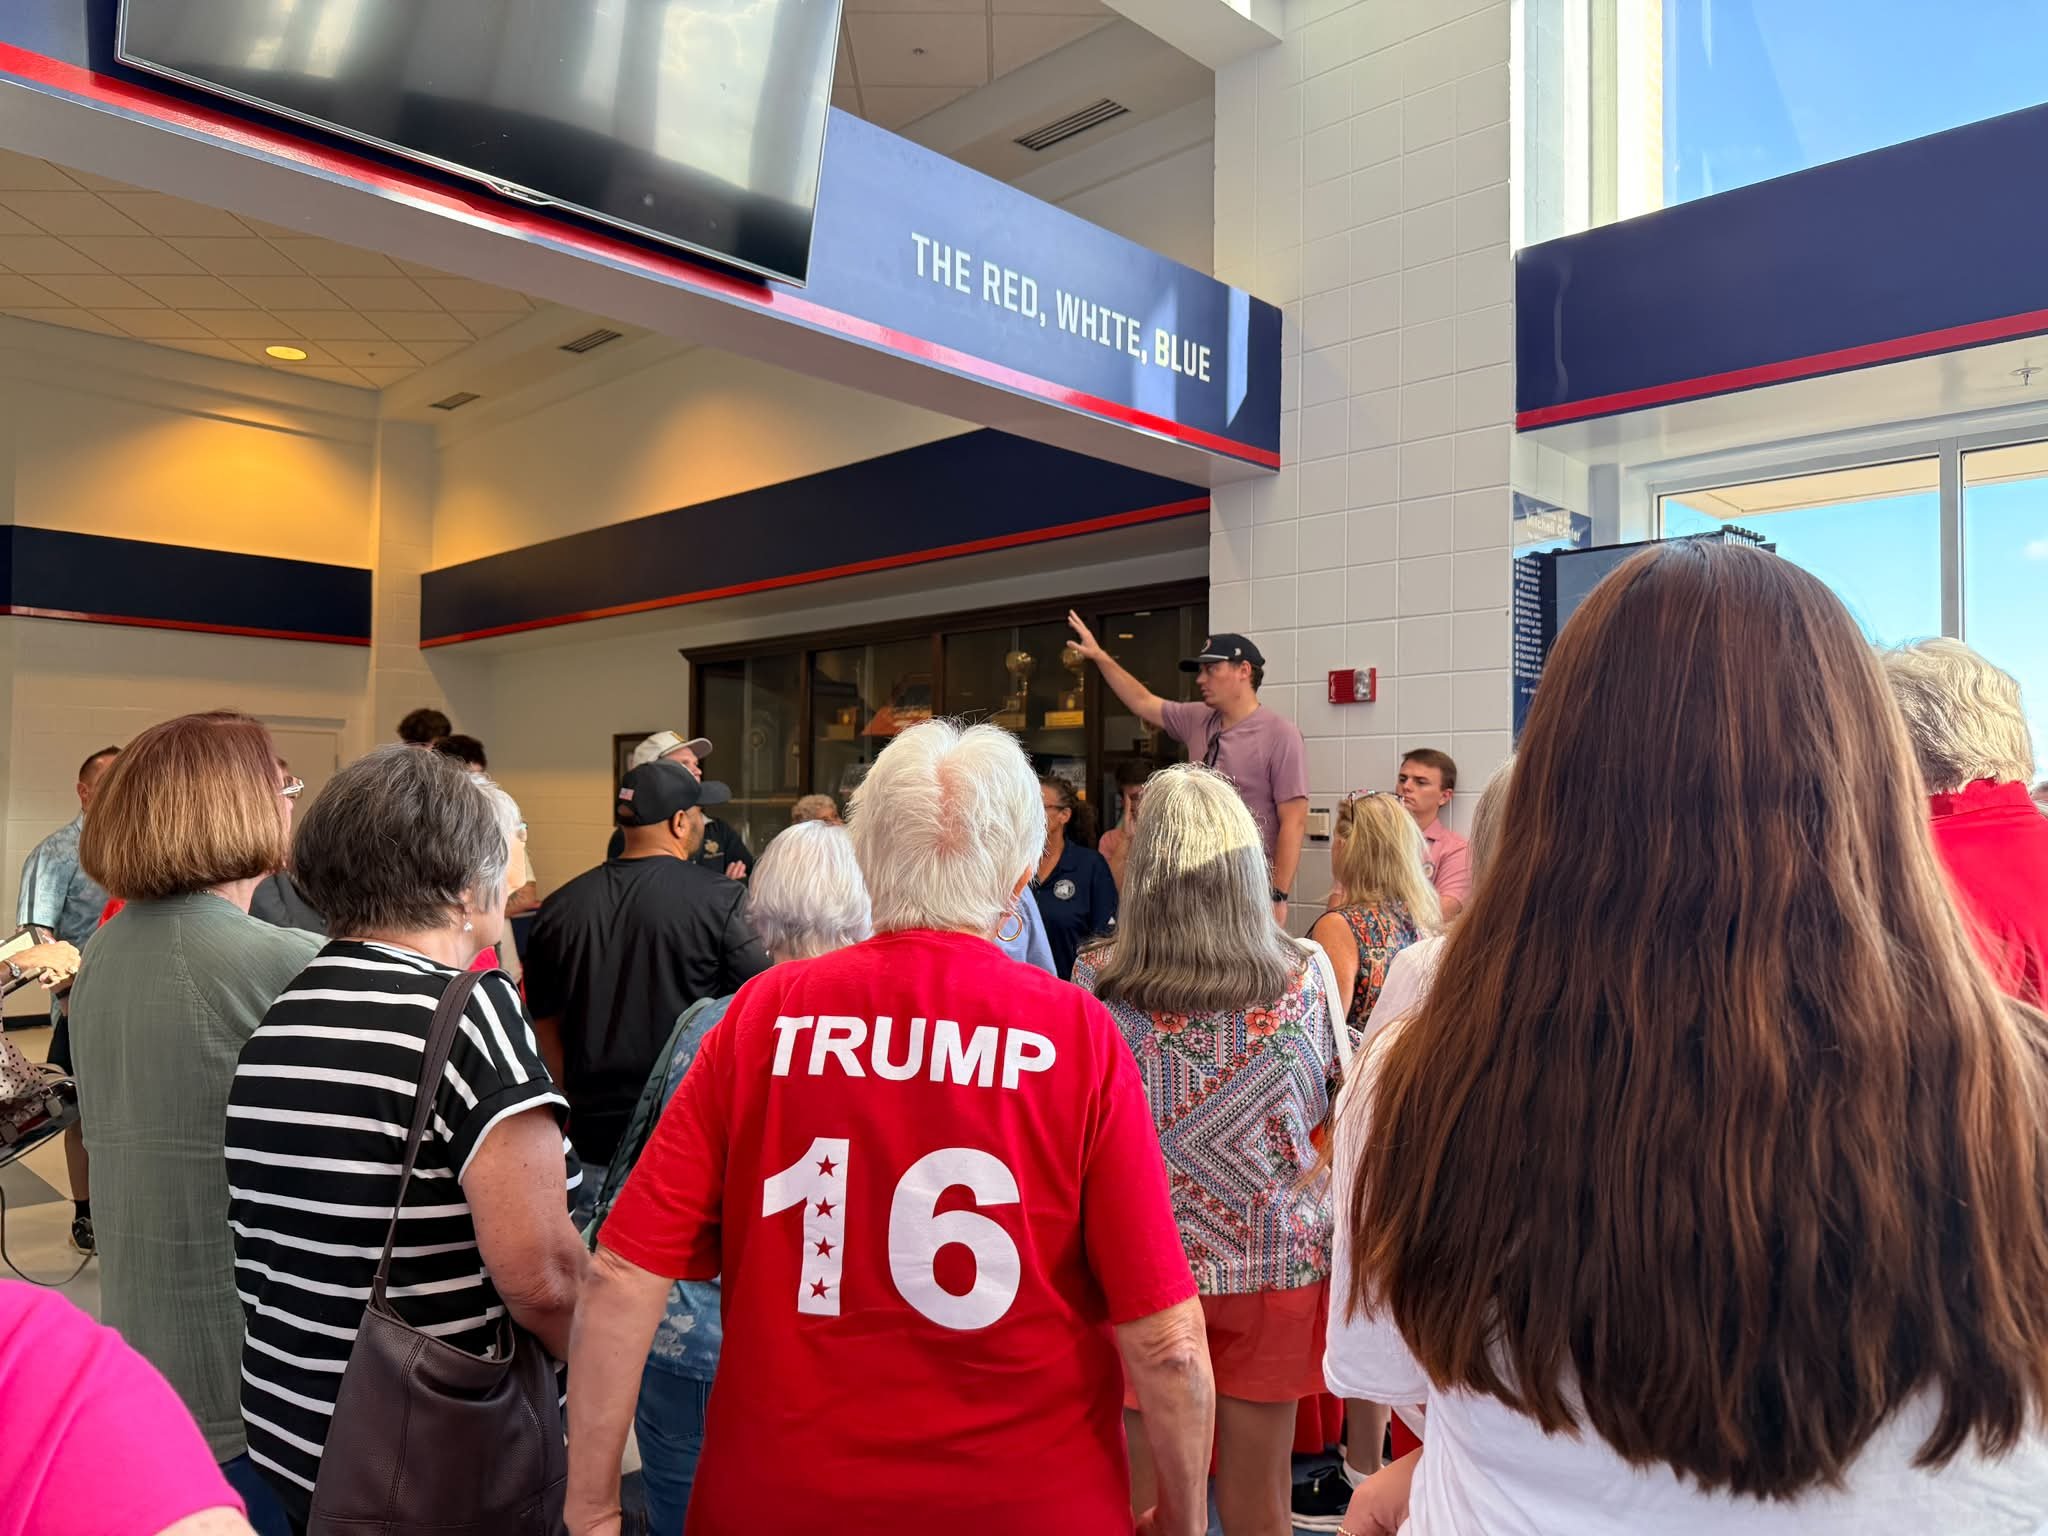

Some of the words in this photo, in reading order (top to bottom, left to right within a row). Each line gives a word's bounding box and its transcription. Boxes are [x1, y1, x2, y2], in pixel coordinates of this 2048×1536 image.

[911, 231, 971, 295] THE
[982, 260, 1047, 328] RED,
[1056, 287, 1148, 365] WHITE,
[1154, 328, 1211, 383] BLUE
[771, 1015, 1057, 1090] TRUMP
[761, 1136, 1022, 1330] 16
